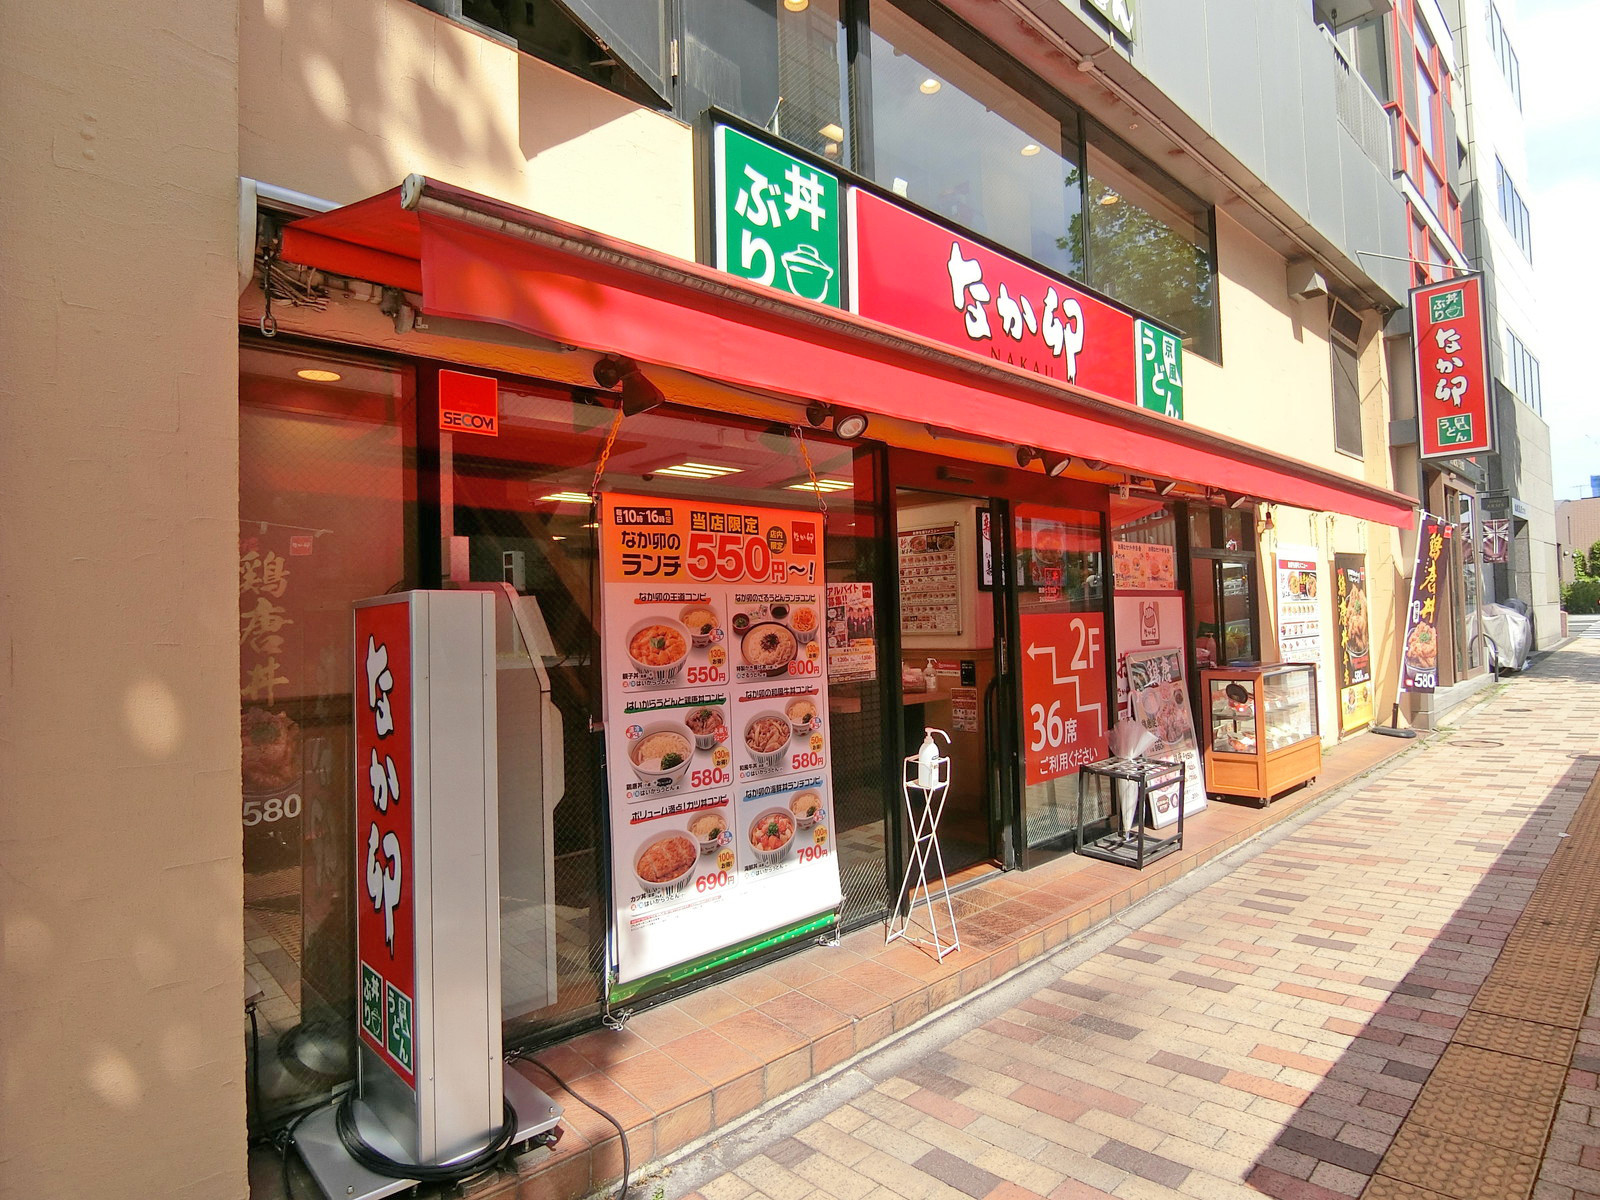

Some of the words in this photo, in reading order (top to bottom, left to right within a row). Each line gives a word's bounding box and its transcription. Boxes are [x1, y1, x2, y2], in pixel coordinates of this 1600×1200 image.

[947, 241, 1085, 386] なか卯
[1434, 328, 1469, 409] なか卯
[443, 411, 494, 430] SECOM
[692, 513, 758, 534] 当店限定
[621, 530, 681, 550] なか卯の
[769, 530, 783, 539] 店内
[770, 541, 784, 550] 限定
[621, 553, 681, 576] ランチ
[1069, 617, 1101, 671] 2F
[687, 665, 726, 683] 550円
[788, 659, 820, 676] 600円
[1414, 673, 1436, 689] 580
[1030, 699, 1078, 752] 36席
[791, 752, 824, 770] 580円
[1039, 747, 1099, 775] ご利用ください
[691, 767, 730, 788] 580円
[366, 633, 402, 959] なか卯
[242, 793, 302, 827] 580
[797, 844, 828, 865] 790円
[696, 869, 735, 894] 690円
